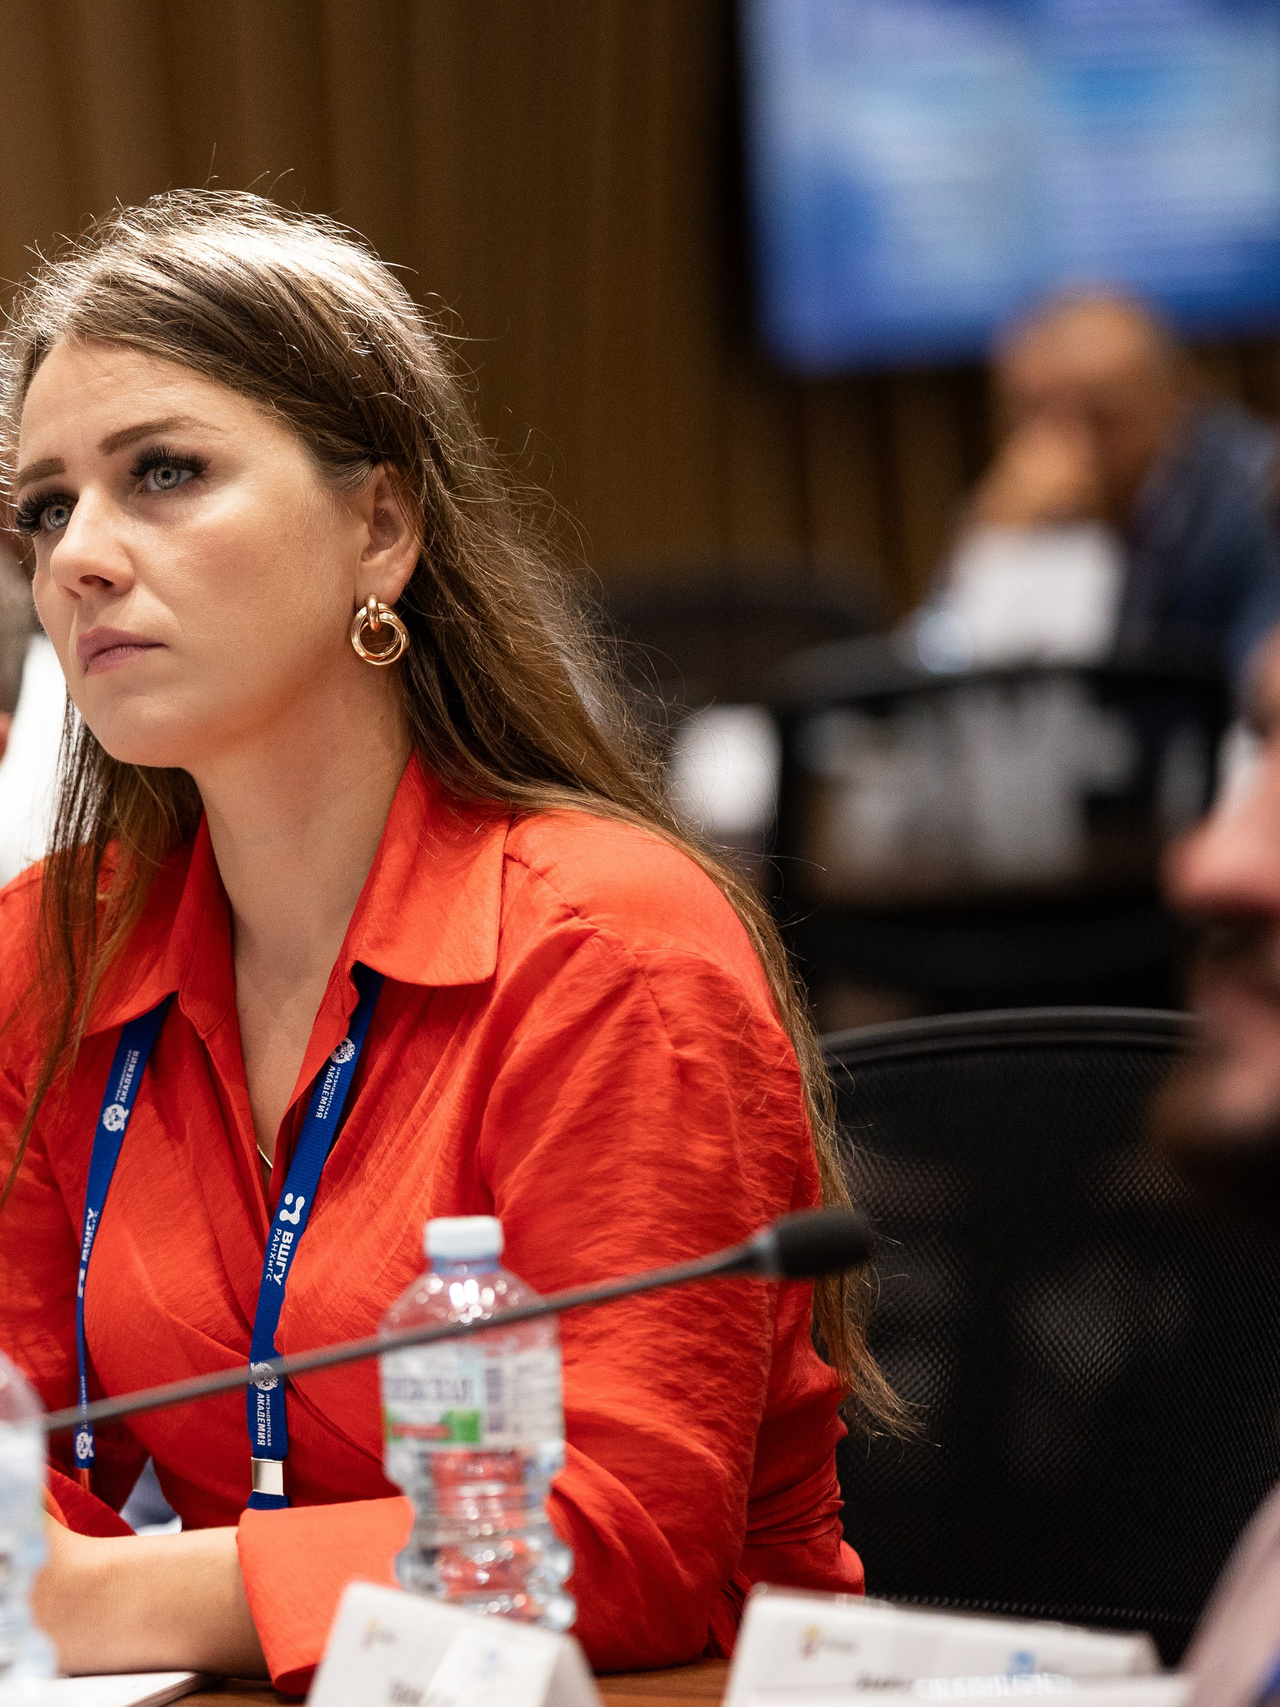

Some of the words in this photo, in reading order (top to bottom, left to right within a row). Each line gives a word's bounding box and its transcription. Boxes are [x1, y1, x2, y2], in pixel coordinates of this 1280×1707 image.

[315, 1064, 336, 1119] АКАДЕМИЯ
[273, 1230, 294, 1286] ВШГУ
[256, 1392, 266, 1446] АКАДЕМИЯ
